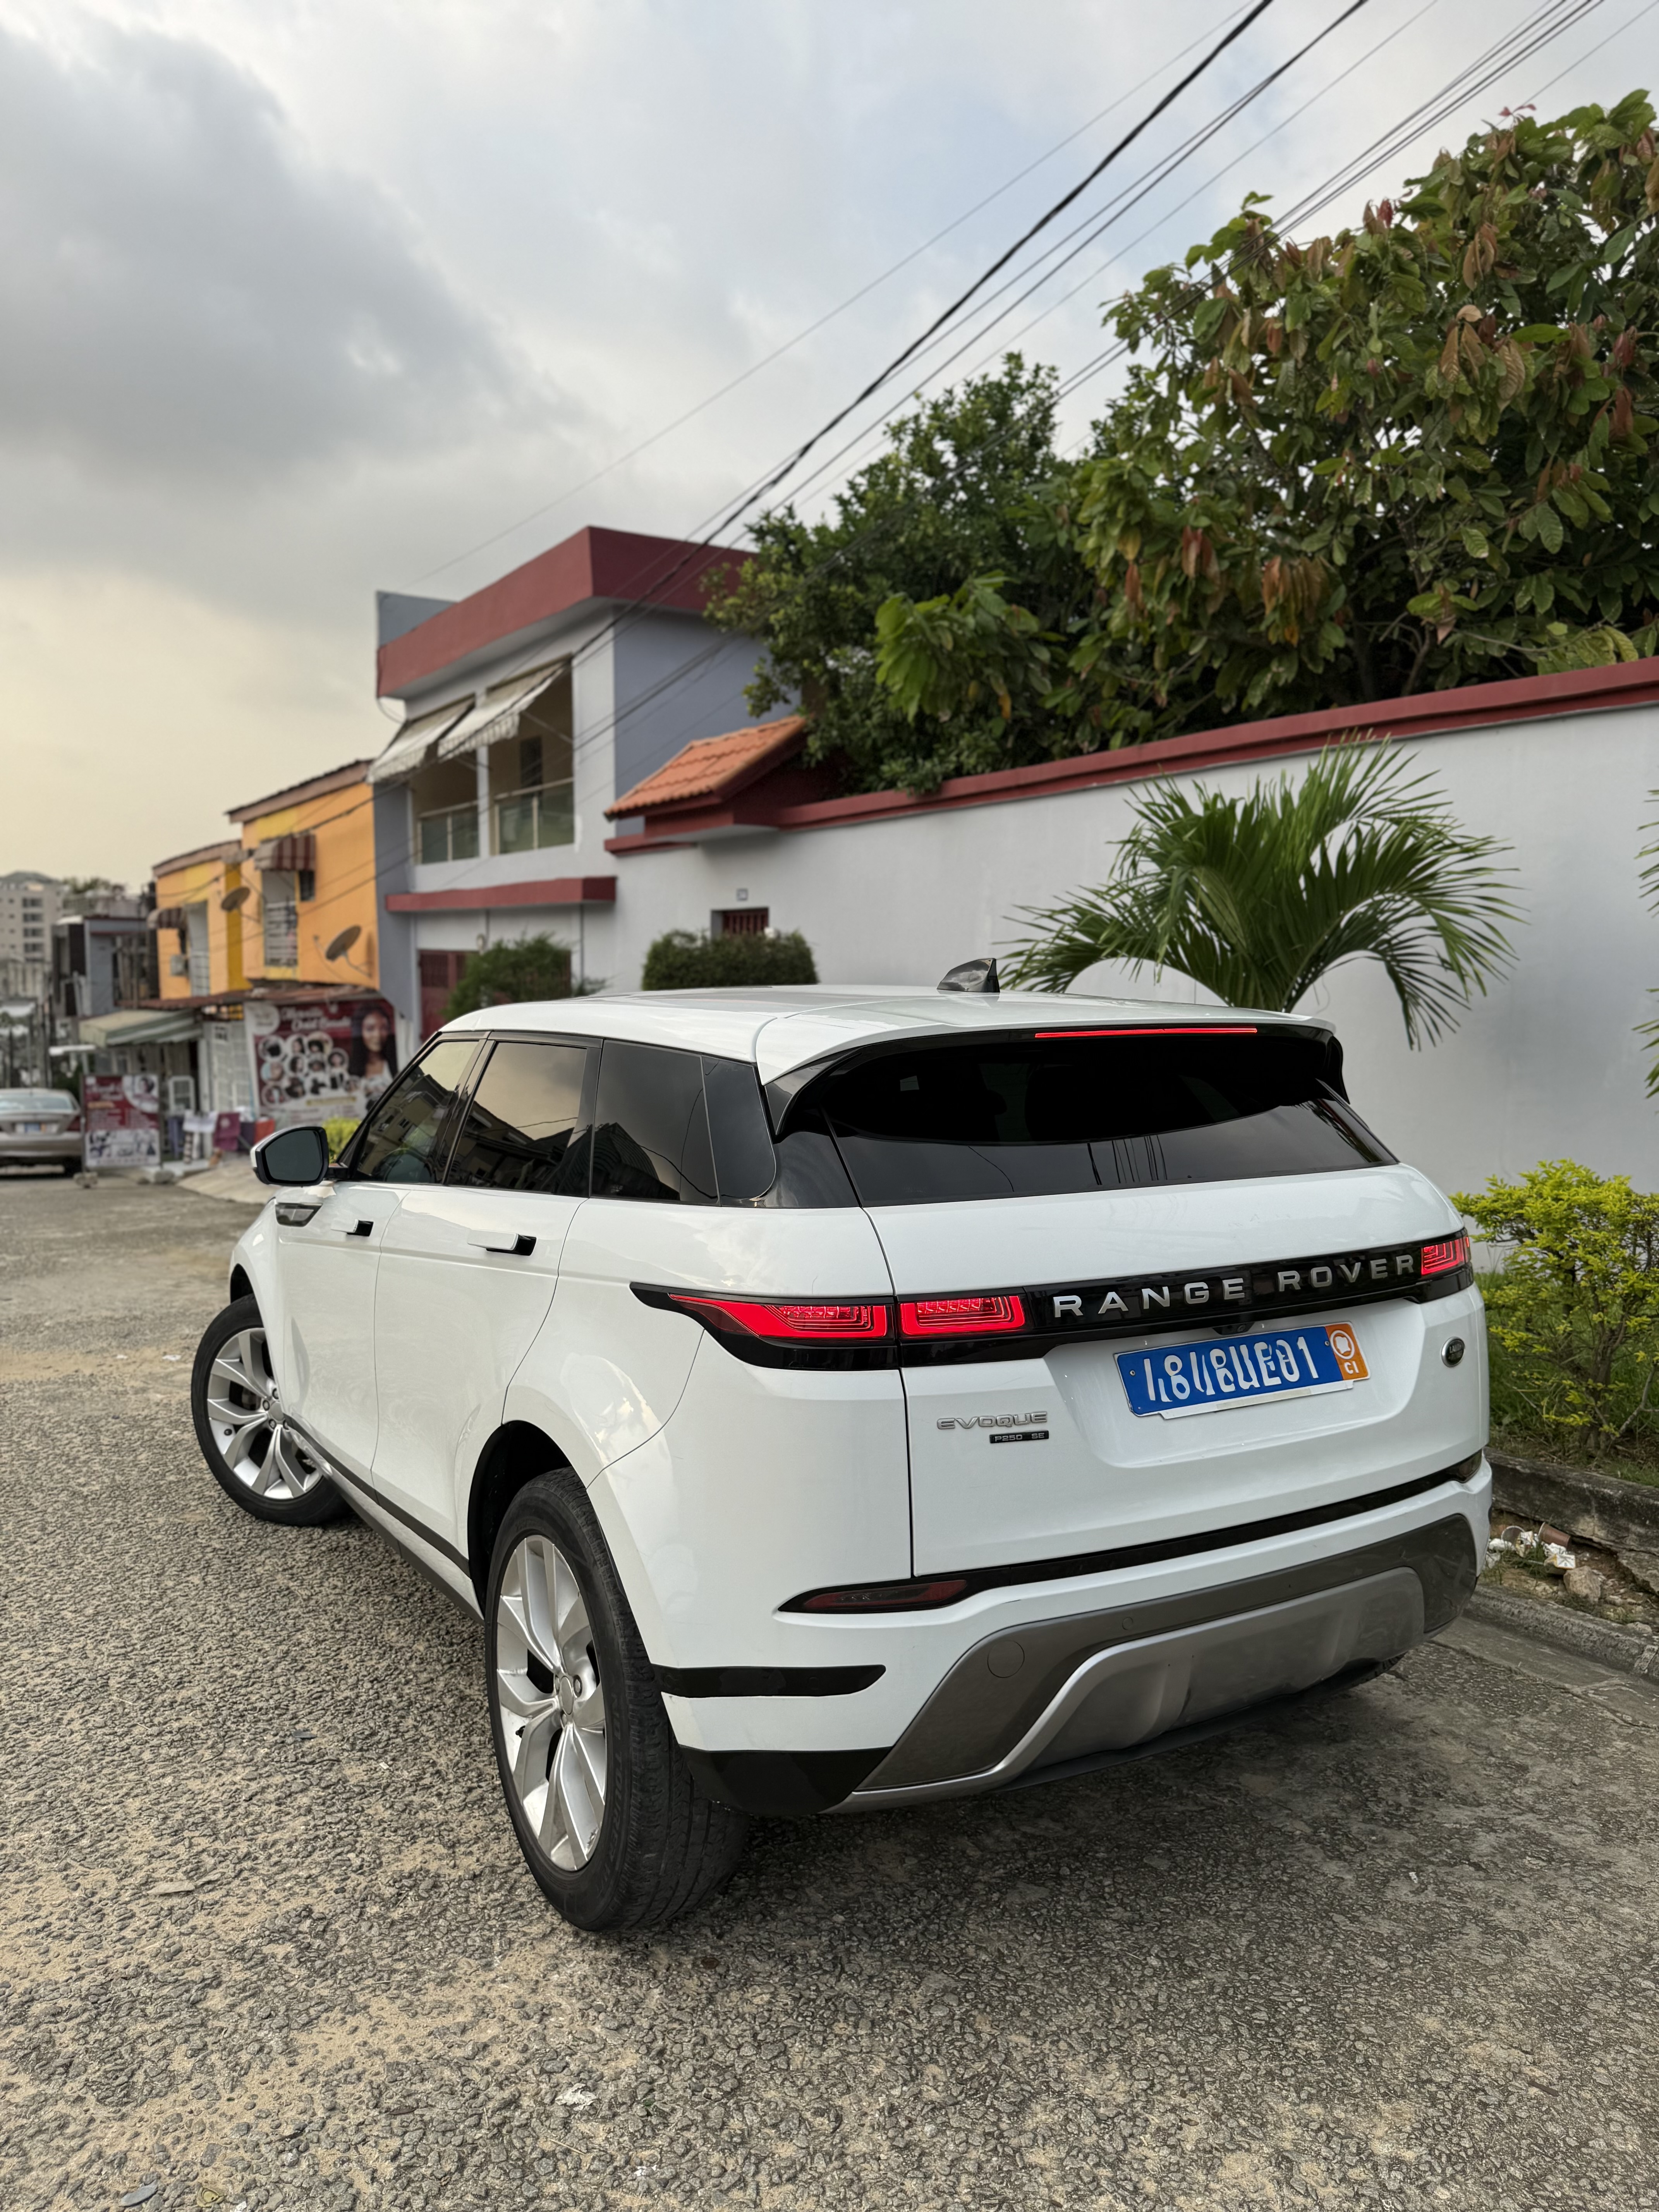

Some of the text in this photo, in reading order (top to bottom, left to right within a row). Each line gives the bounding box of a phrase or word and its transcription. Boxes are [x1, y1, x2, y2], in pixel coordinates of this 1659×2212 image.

[1053, 1255, 1413, 1317] RANGE ROVER
[937, 1411, 1047, 1430] EVOQUE
